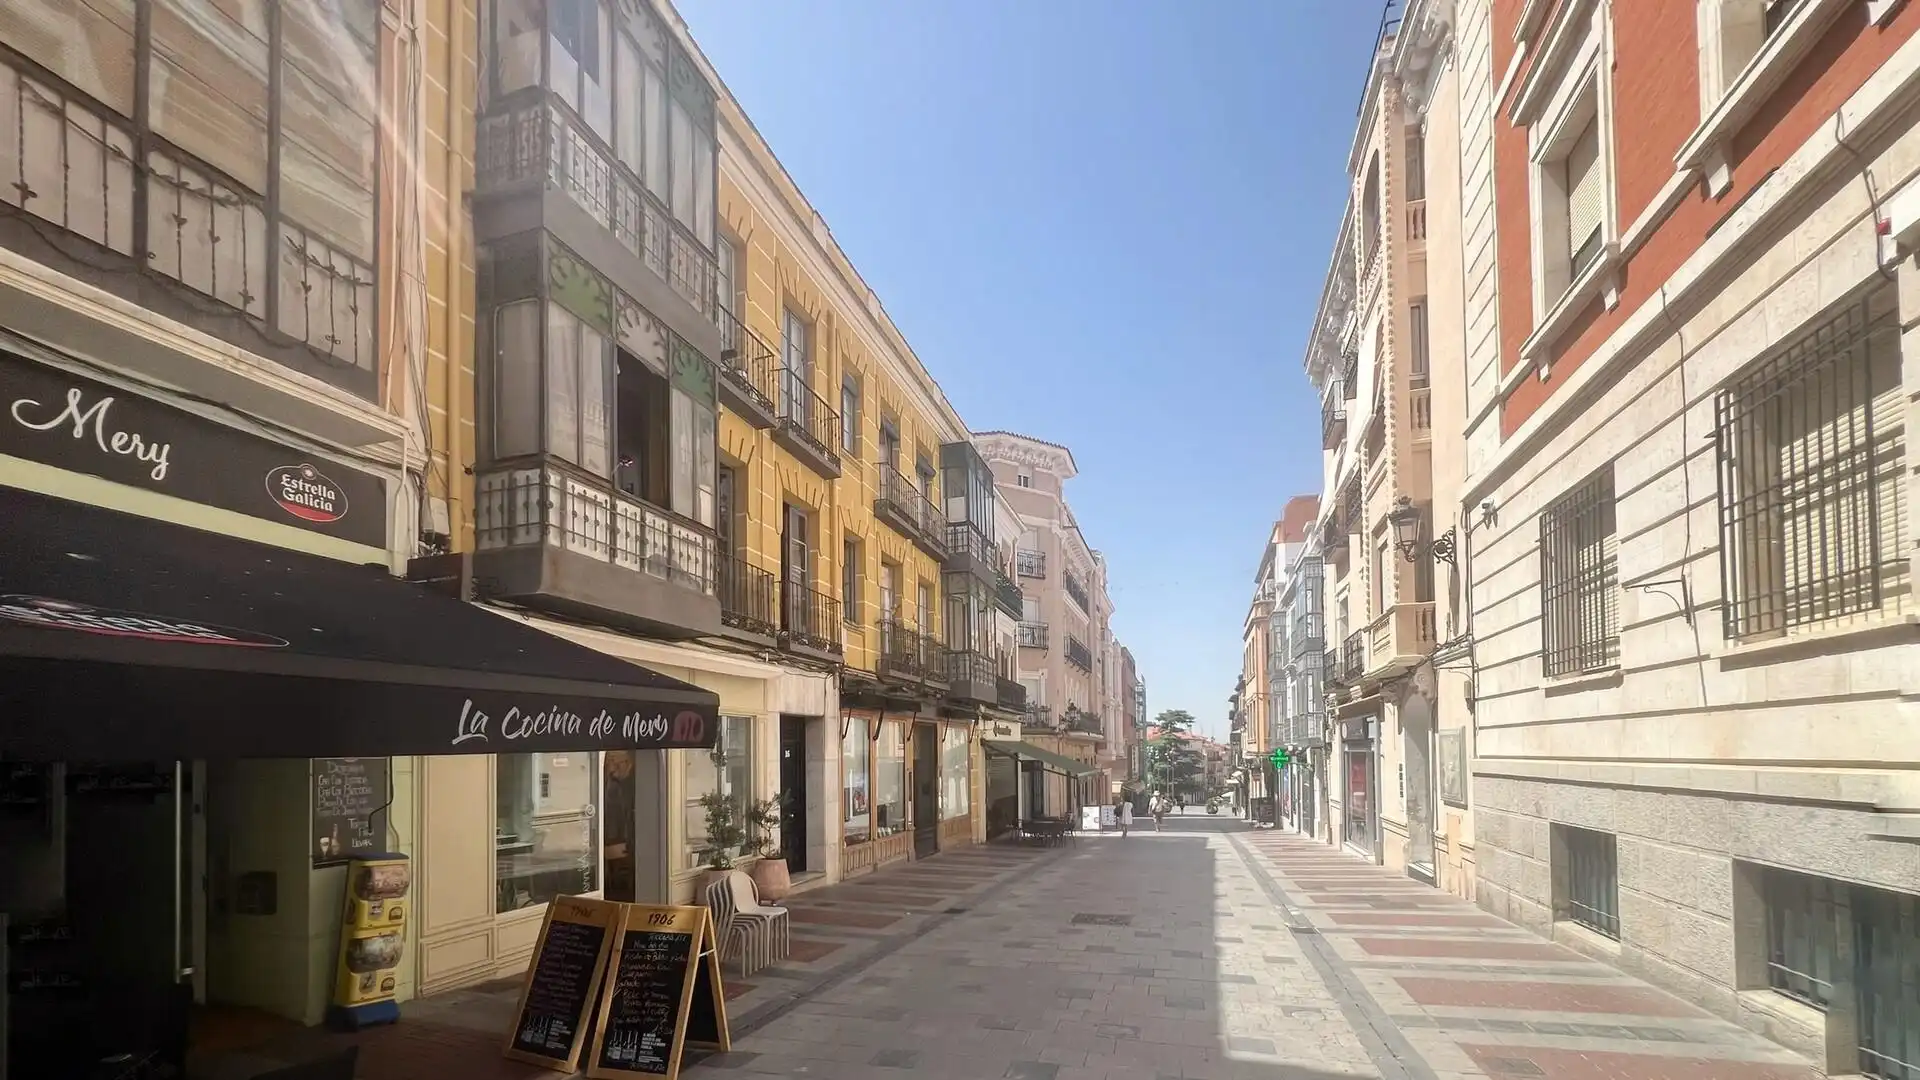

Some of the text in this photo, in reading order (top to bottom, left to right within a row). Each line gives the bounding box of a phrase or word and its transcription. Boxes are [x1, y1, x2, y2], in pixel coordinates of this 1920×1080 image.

[11, 388, 171, 481] Mery
[281, 473, 336, 500] Estrella
[282, 487, 334, 512] Galicia
[452, 699, 669, 745] La Cocina de Mery
[647, 912, 676, 927] 1906
